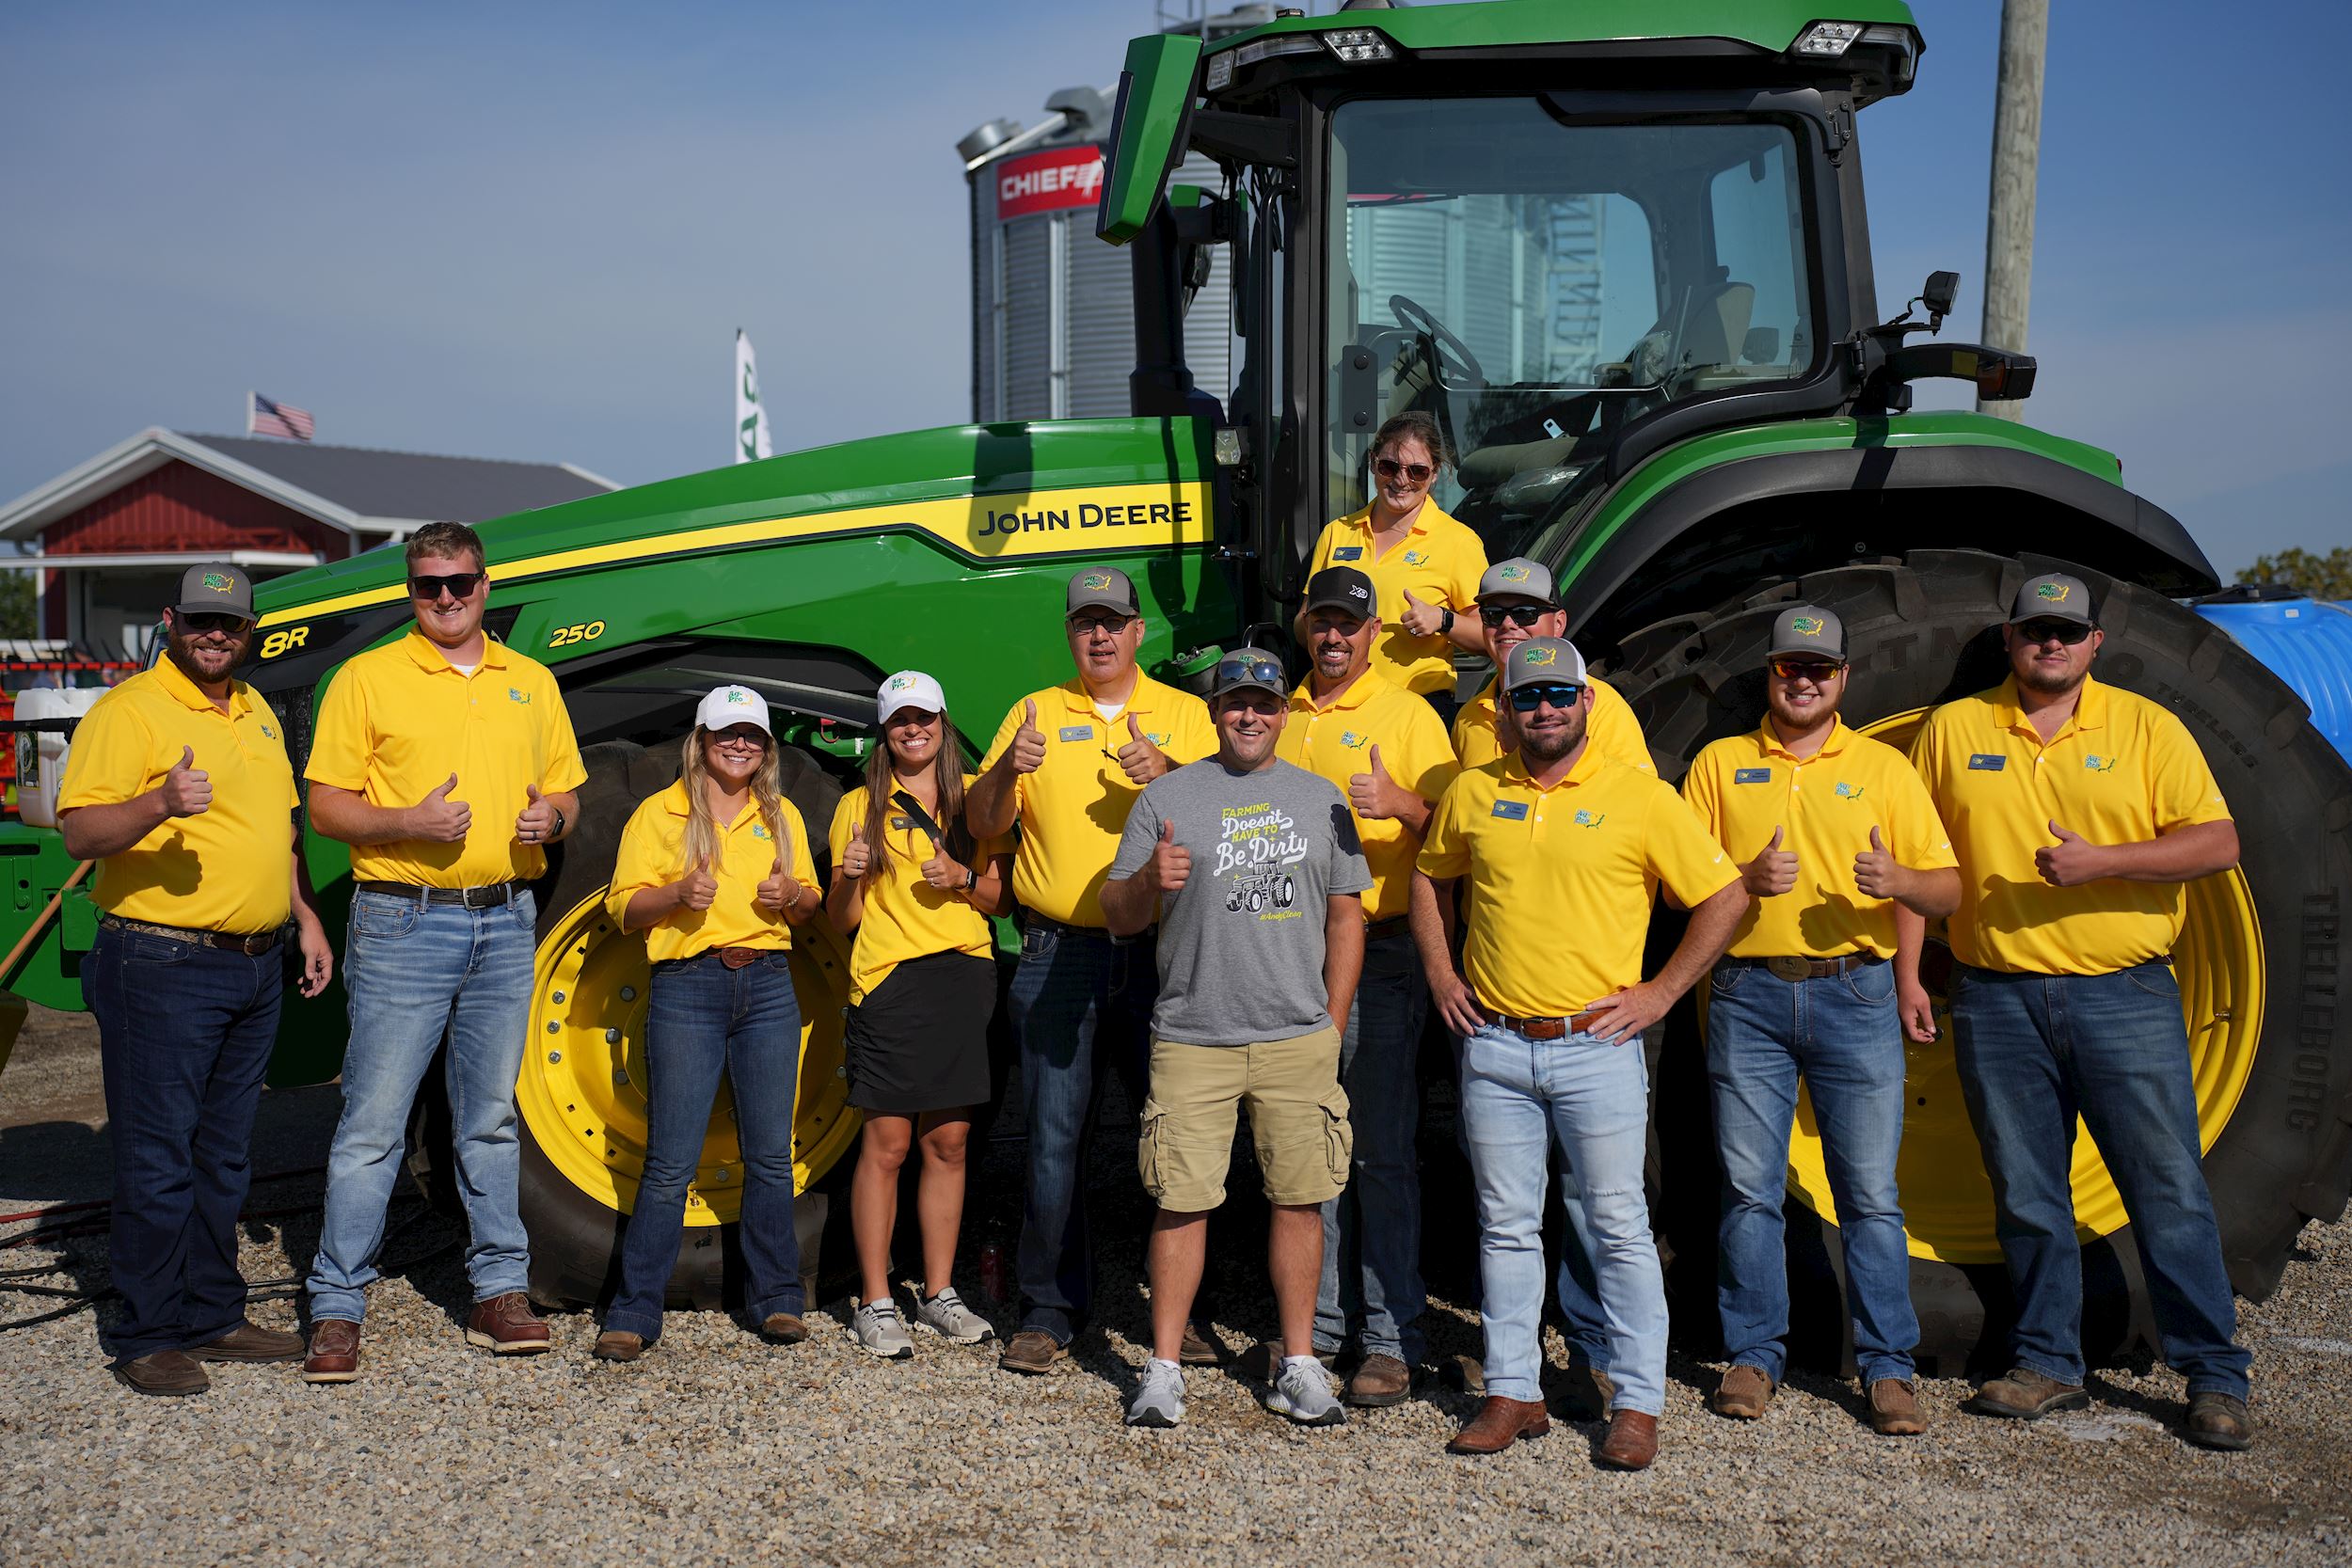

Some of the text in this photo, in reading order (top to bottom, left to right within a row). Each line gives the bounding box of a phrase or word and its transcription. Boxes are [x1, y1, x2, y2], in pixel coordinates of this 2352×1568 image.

[1001, 164, 1078, 201] CHIEF
[978, 502, 1192, 536] JOHN DEERE
[260, 626, 310, 658] 8R
[548, 620, 607, 649] 250
[2156, 681, 2258, 768] TUBELESS
[1222, 802, 1270, 819] FARMING
[1222, 809, 1294, 839] Doesn't
[1232, 824, 1279, 843] HAVE TO
[1213, 831, 1308, 877] Be Dirty
[2285, 885, 2341, 1134] TRELLEBORG
